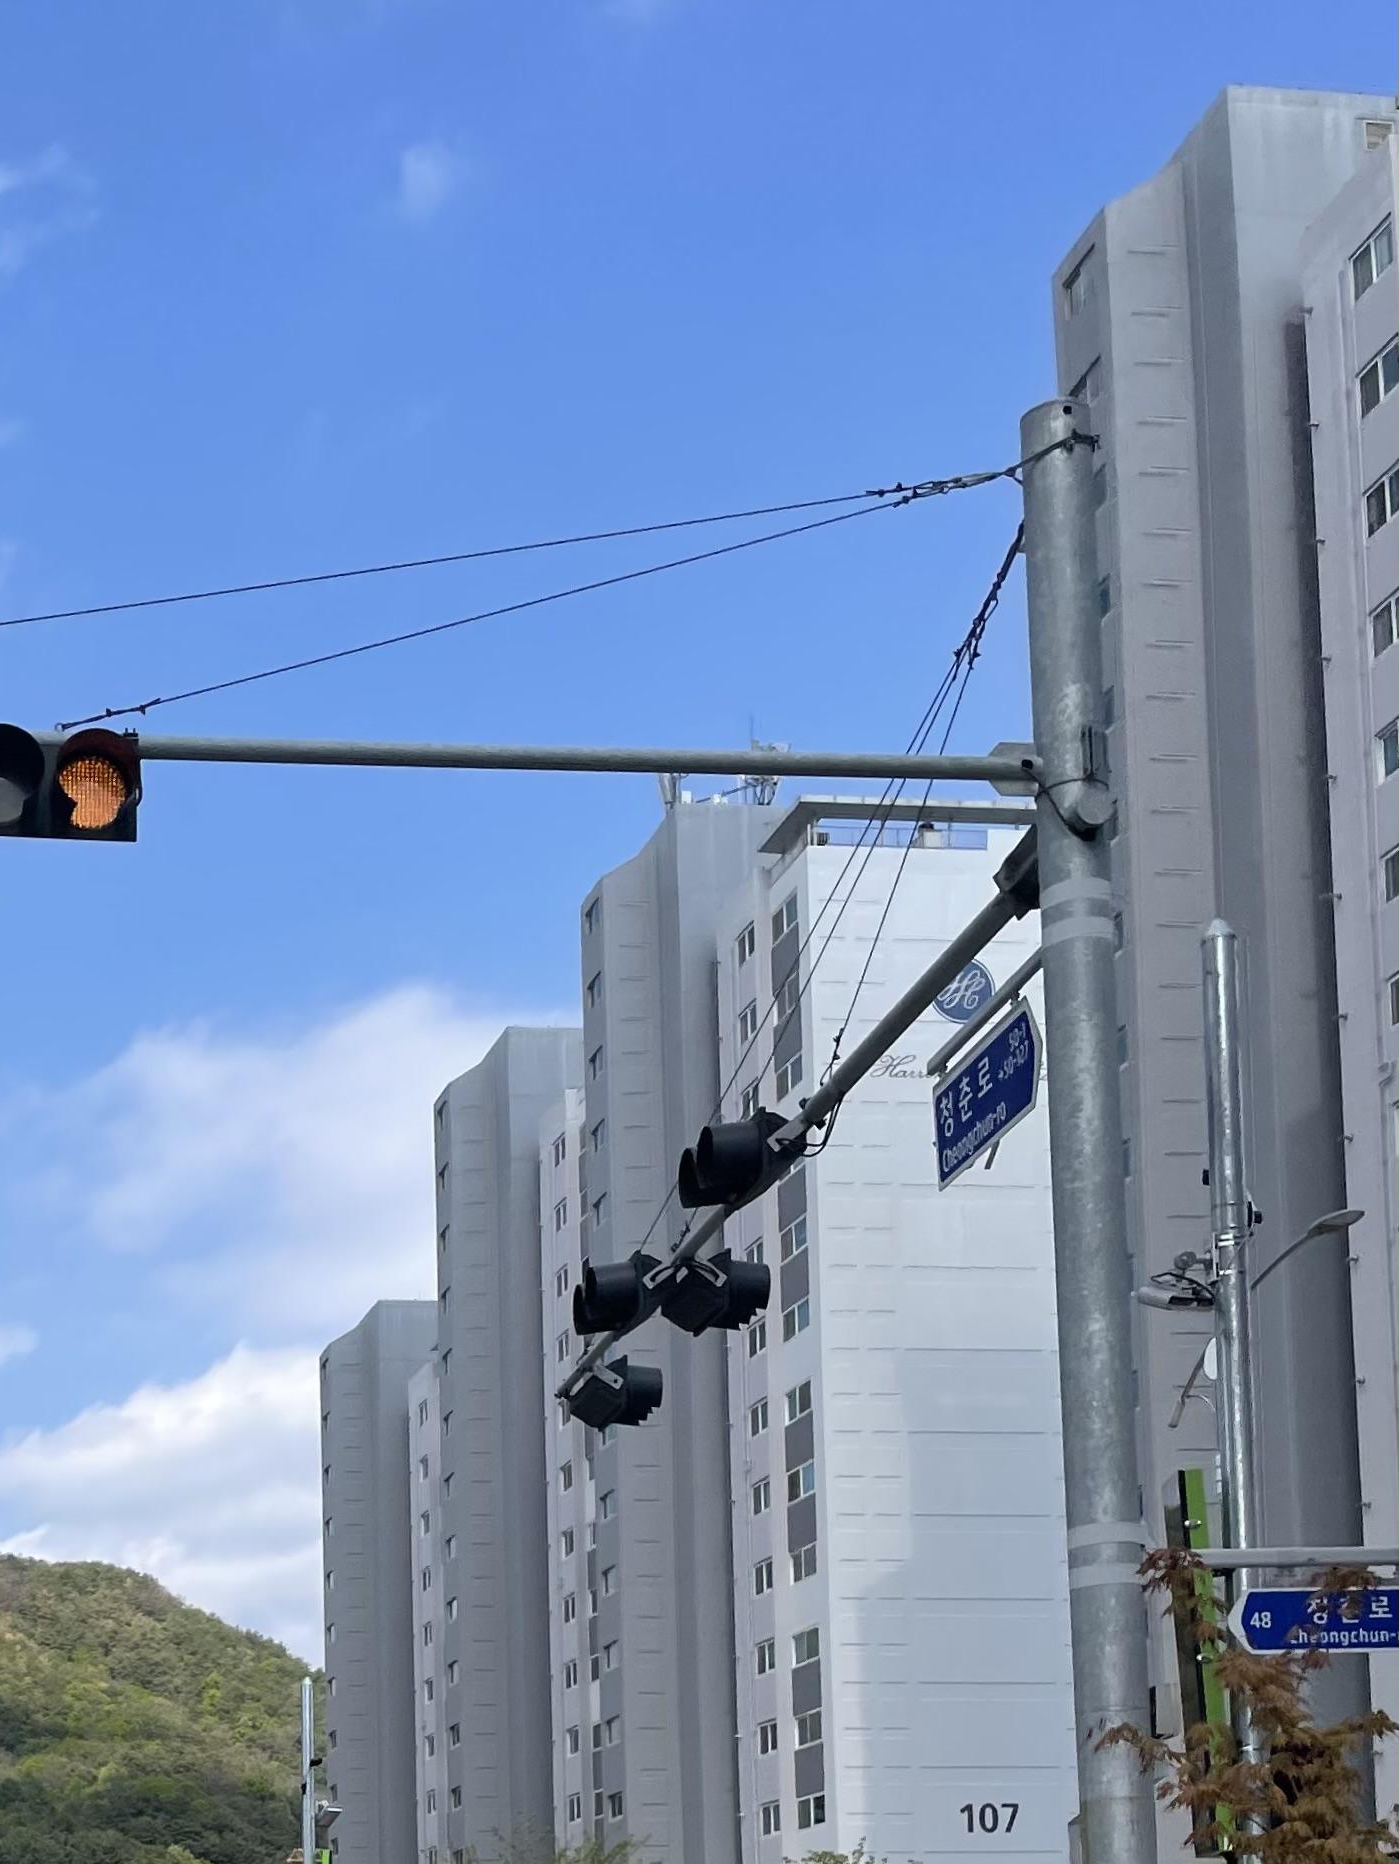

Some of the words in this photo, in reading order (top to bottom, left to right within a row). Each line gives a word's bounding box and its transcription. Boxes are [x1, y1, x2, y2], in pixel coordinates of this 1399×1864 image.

[940, 1056, 993, 1137] 청춘로
[942, 1101, 1007, 1173] Cheongchun-ro
[1250, 1611, 1272, 1629] 48
[960, 1802, 1019, 1834] 107
